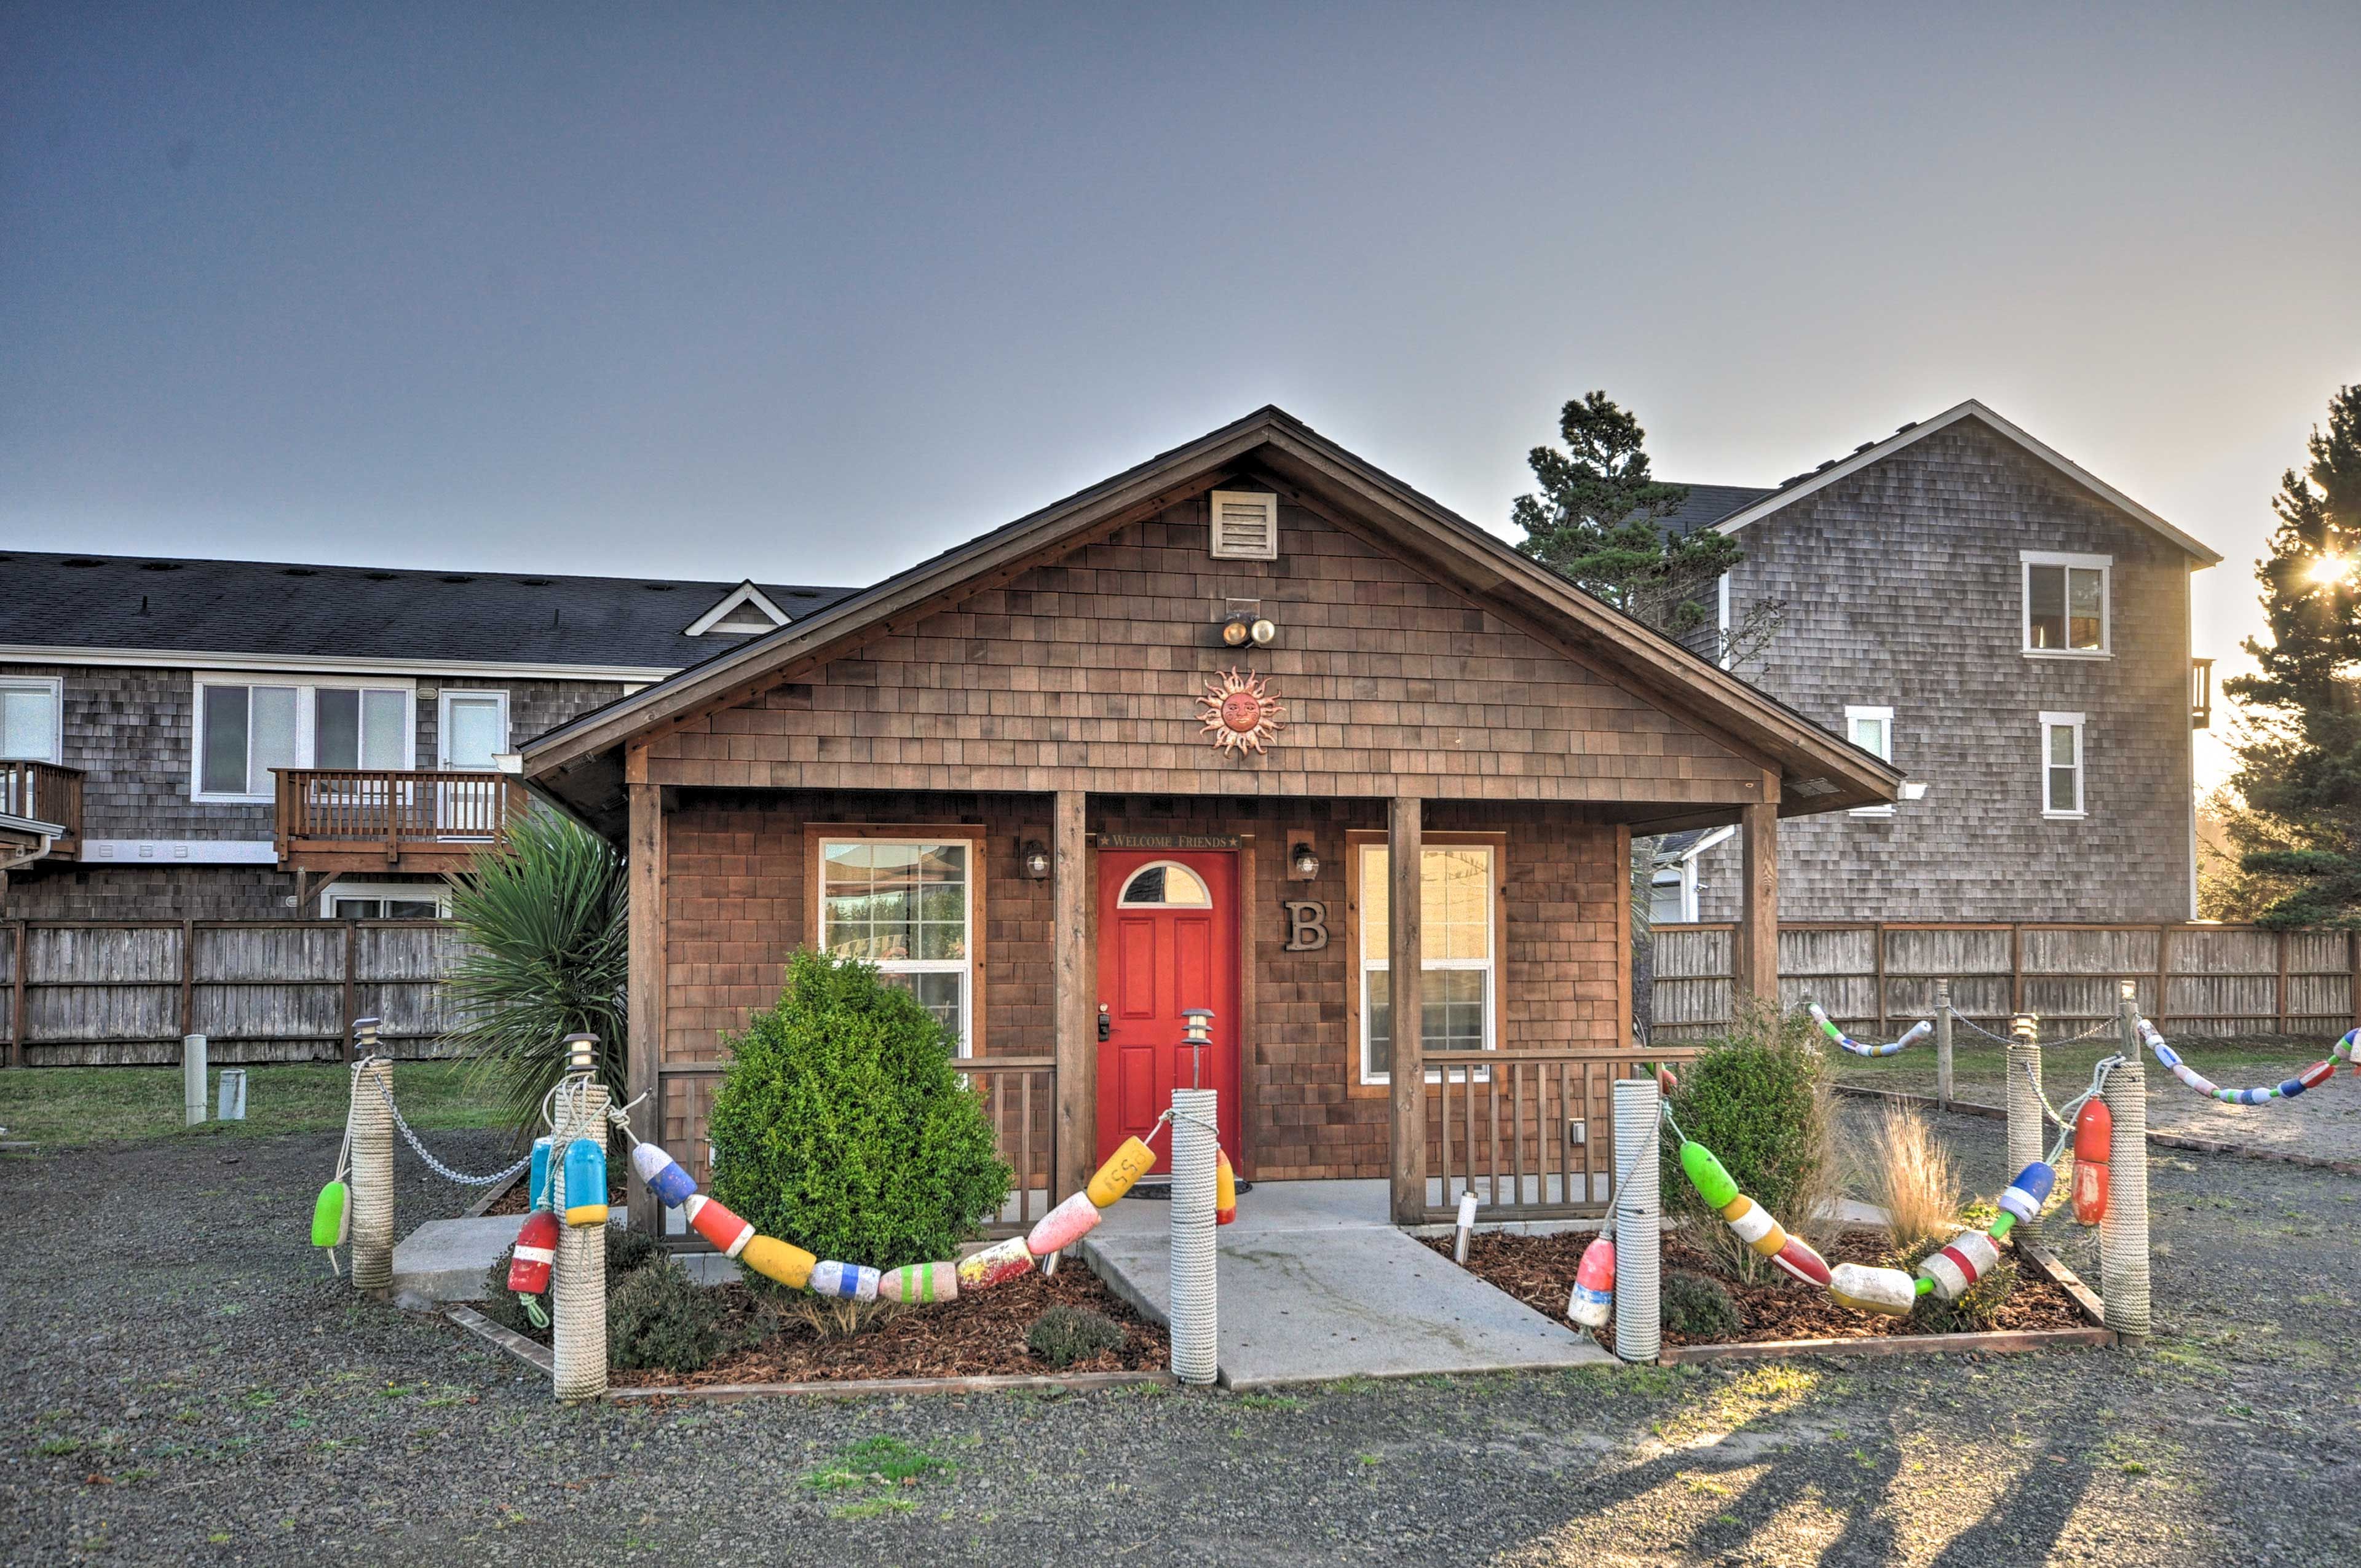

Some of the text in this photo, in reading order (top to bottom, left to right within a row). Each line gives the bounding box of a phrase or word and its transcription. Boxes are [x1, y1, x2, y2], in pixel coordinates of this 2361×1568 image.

[1113, 835, 1227, 847] WELCOME FRIENDS
[1284, 901, 1329, 951] B
